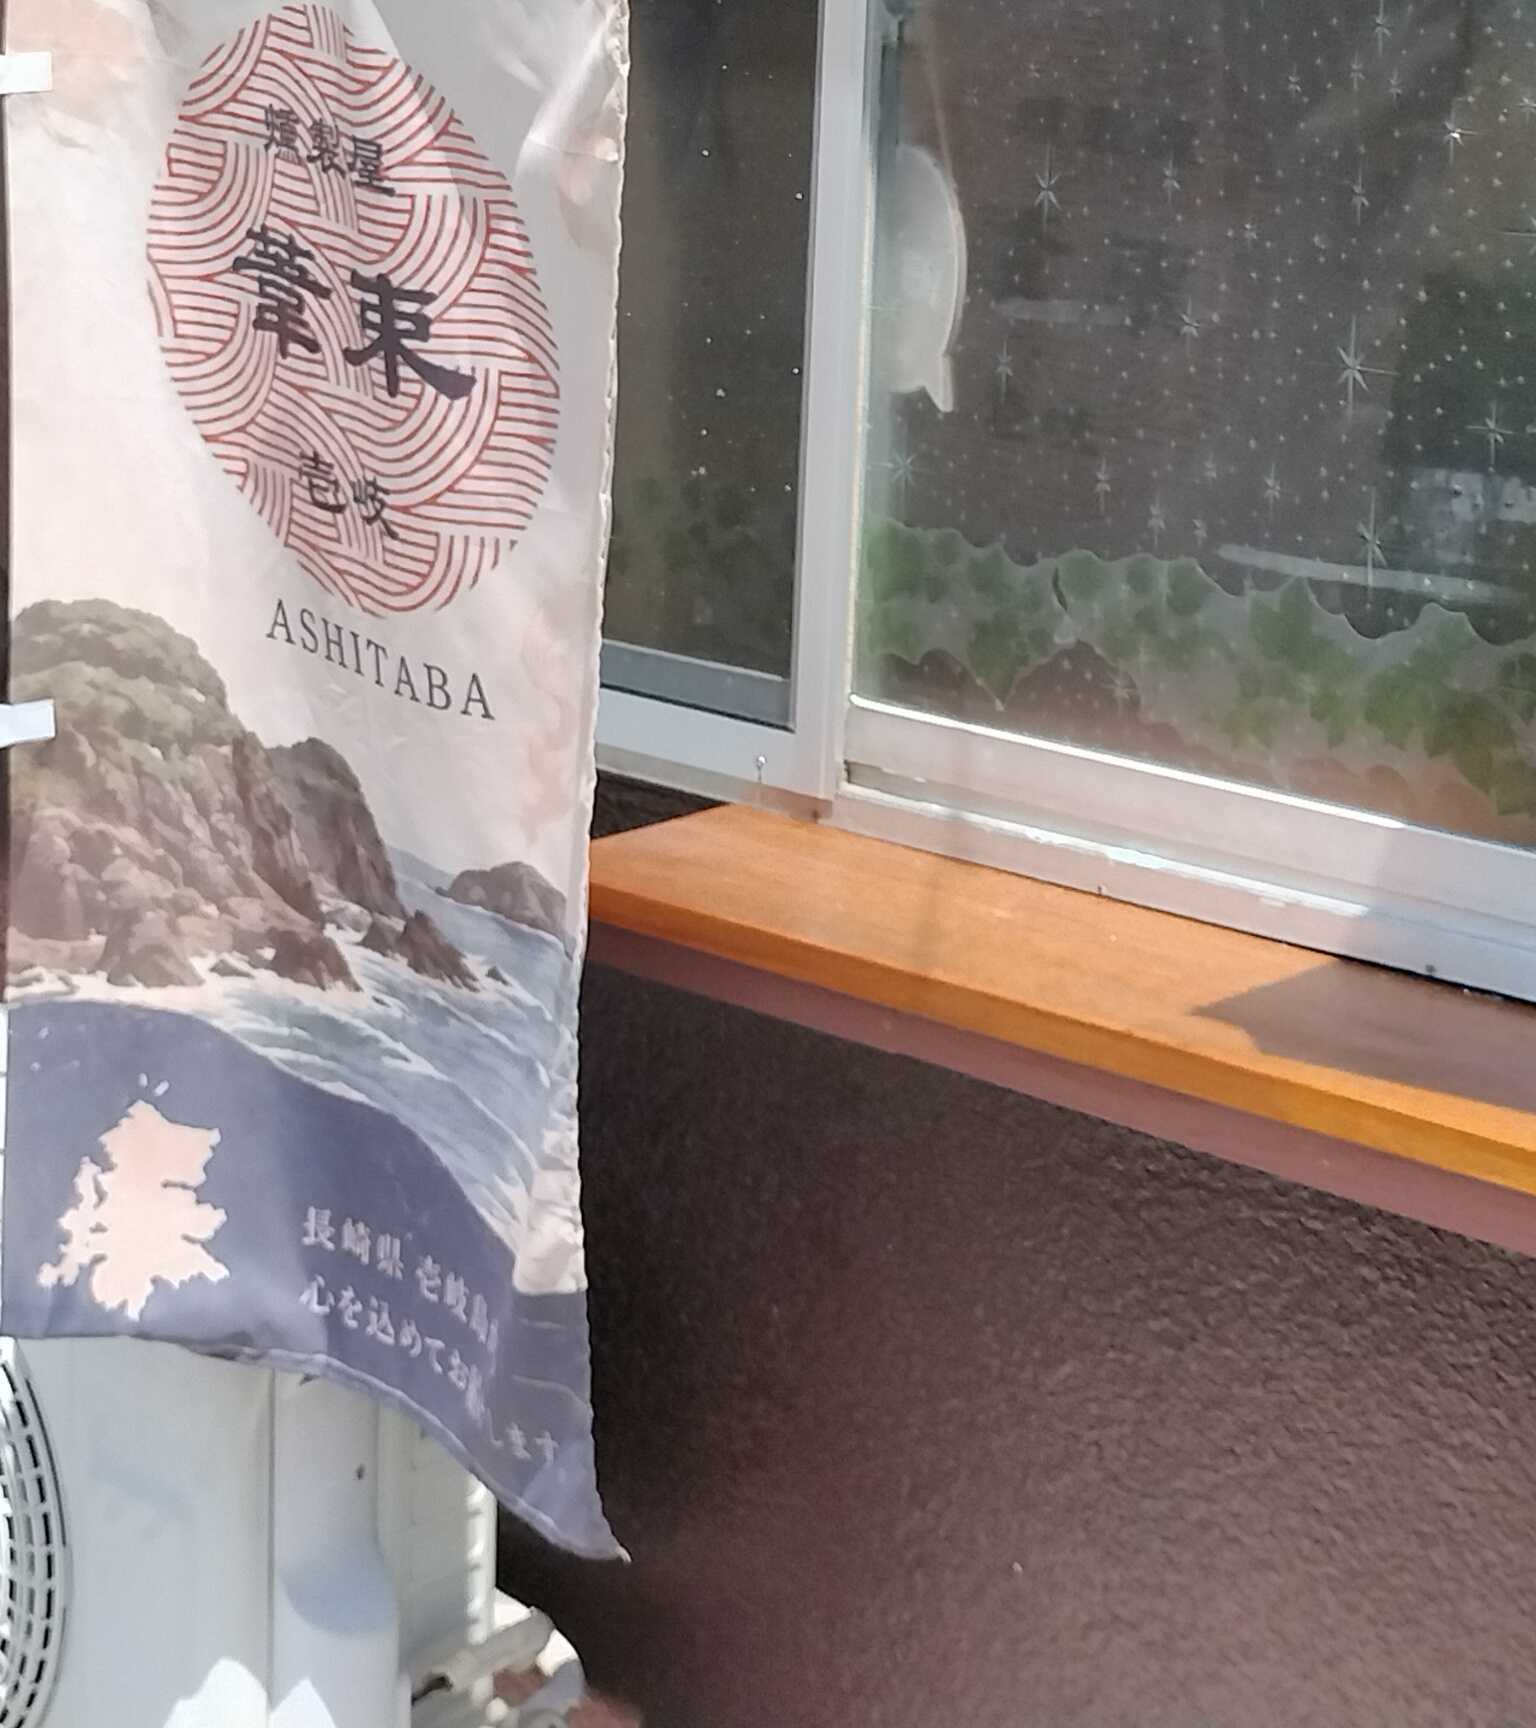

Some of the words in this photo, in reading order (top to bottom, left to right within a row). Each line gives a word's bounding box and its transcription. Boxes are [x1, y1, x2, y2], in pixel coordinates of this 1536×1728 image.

[263, 104, 396, 197] 燻製屋
[232, 225, 477, 400] 葦束
[298, 450, 400, 540] 壱岐
[265, 597, 496, 721] ASHITABA
